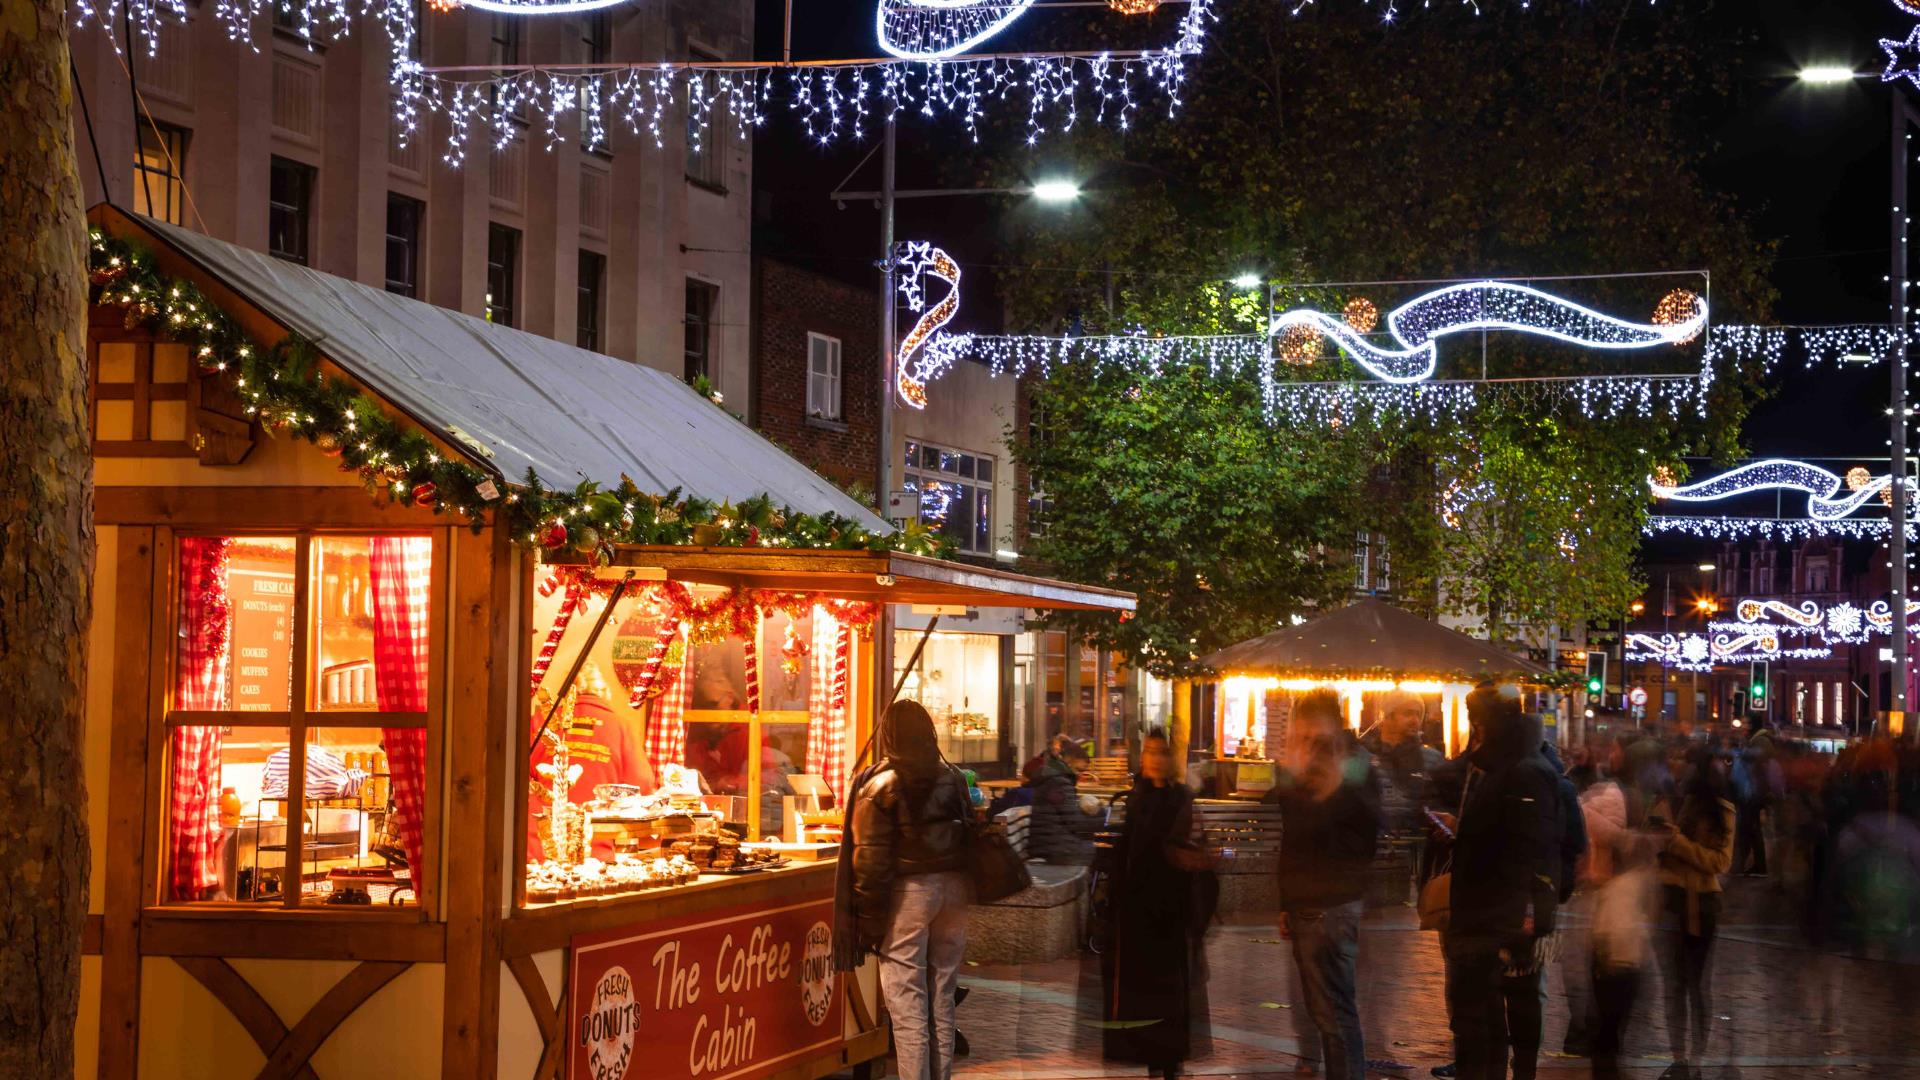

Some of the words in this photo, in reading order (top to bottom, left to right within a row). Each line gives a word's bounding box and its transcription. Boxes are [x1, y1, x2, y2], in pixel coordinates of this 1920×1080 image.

[253, 579, 278, 593] FRESH
[279, 582, 295, 594] CAK
[243, 600, 268, 611] DONUTS
[241, 647, 268, 658] COOKIES
[240, 666, 268, 676] MUFFINS
[240, 684, 261, 695] CAKES
[807, 927, 830, 954] FRESH
[653, 940, 700, 1010] The
[716, 924, 791, 993] Coffee
[598, 974, 630, 1005] FRESH
[805, 984, 832, 1022] FRESH
[582, 1003, 640, 1046] DONUTS
[690, 1004, 756, 1076] Cabin
